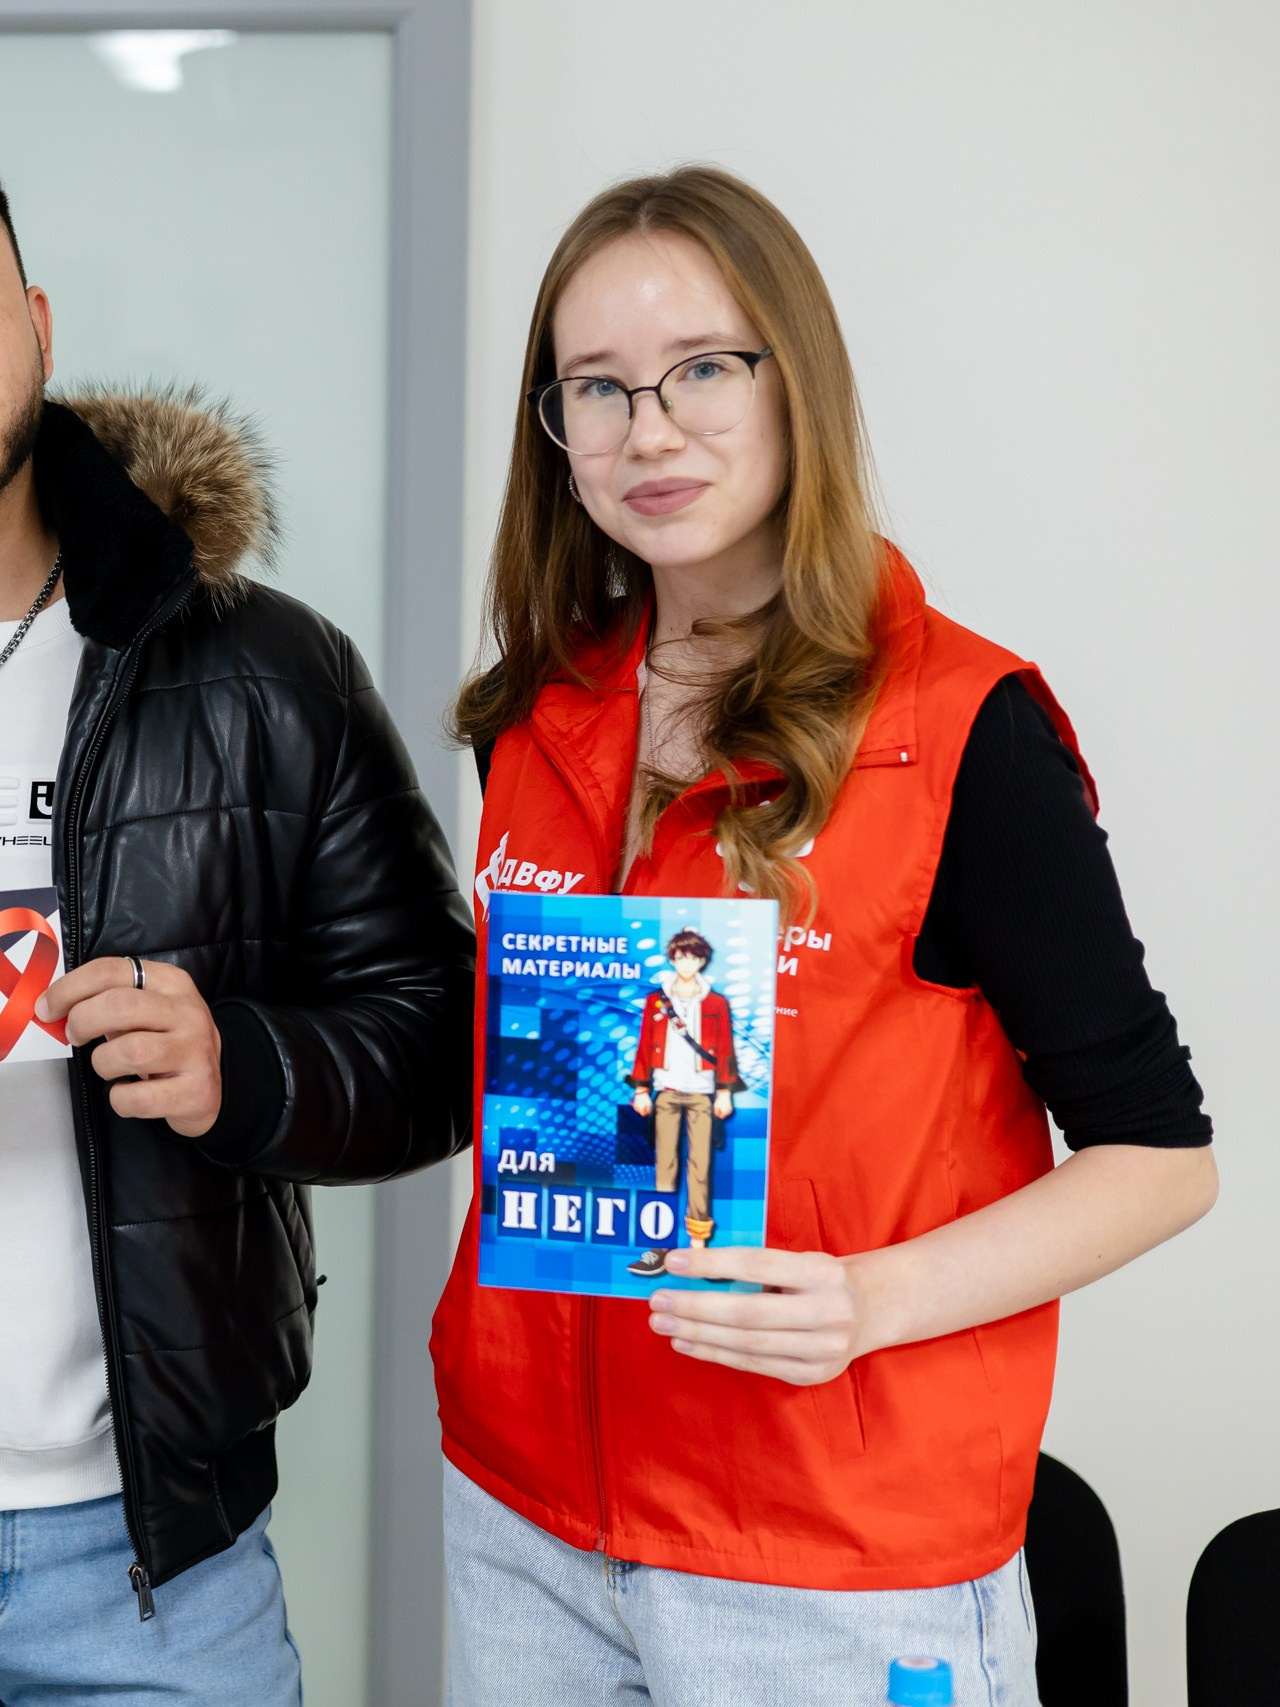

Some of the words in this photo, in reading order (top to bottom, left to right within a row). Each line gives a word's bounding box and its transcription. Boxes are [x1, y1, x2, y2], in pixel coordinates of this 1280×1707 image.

[502, 932, 629, 955] СЕКРЕТНЫЕ
[502, 957, 641, 980] МАТЕРИАЛЫ
[497, 1149, 556, 1174] ДЛЯ
[502, 1190, 675, 1240] НЕГО
